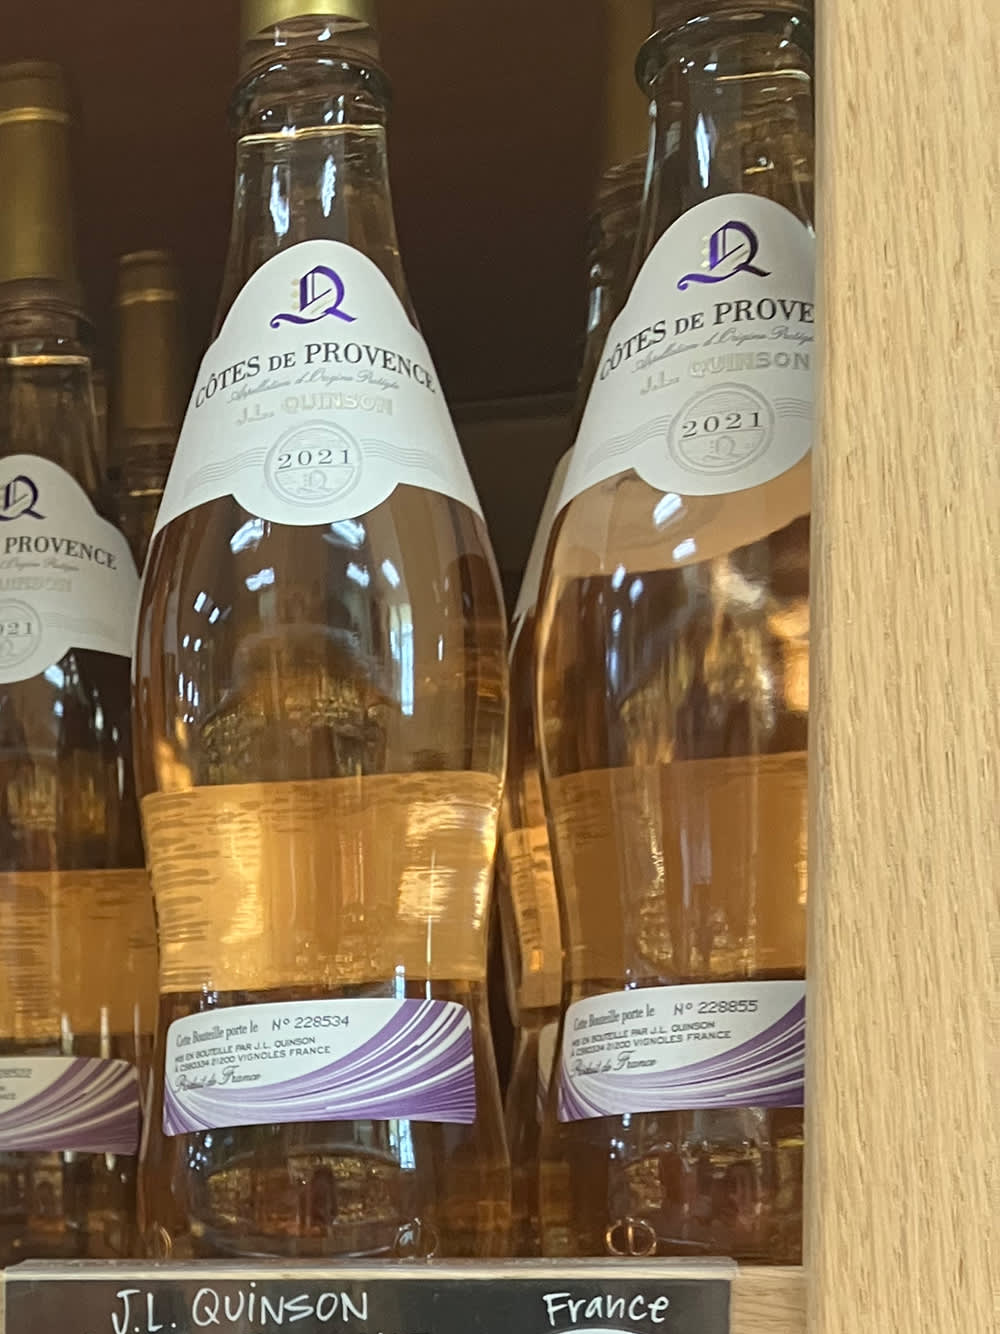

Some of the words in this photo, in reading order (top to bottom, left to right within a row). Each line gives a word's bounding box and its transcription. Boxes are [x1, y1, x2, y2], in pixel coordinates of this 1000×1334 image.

[599, 319, 667, 381] CÔTES
[674, 312, 705, 336] DE
[712, 298, 815, 326] PROVE
[195, 355, 261, 409] CÔTES
[268, 351, 297, 372] DE
[305, 342, 436, 394] PROVENCE
[281, 391, 393, 416] QUINSON
[680, 411, 764, 439] 2021
[277, 448, 353, 470] 2021
[4, 535, 118, 571] PROVENCE
[646, 1003, 656, 1018] le
[697, 1000, 759, 1015] 228855
[225, 1022, 248, 1041] porte
[249, 1018, 259, 1033] le
[294, 1015, 350, 1030] 228534
[671, 1020, 716, 1033] QUINSON
[235, 1043, 253, 1053] PAR
[274, 1036, 316, 1048] QUINSON
[633, 1034, 684, 1047] VIGNOLES
[687, 1030, 732, 1041] FRANCE
[237, 1049, 287, 1063] VIGNOLES
[288, 1046, 331, 1057] FRANCE
[217, 1064, 261, 1085] France
[542, 1292, 670, 1327] France
